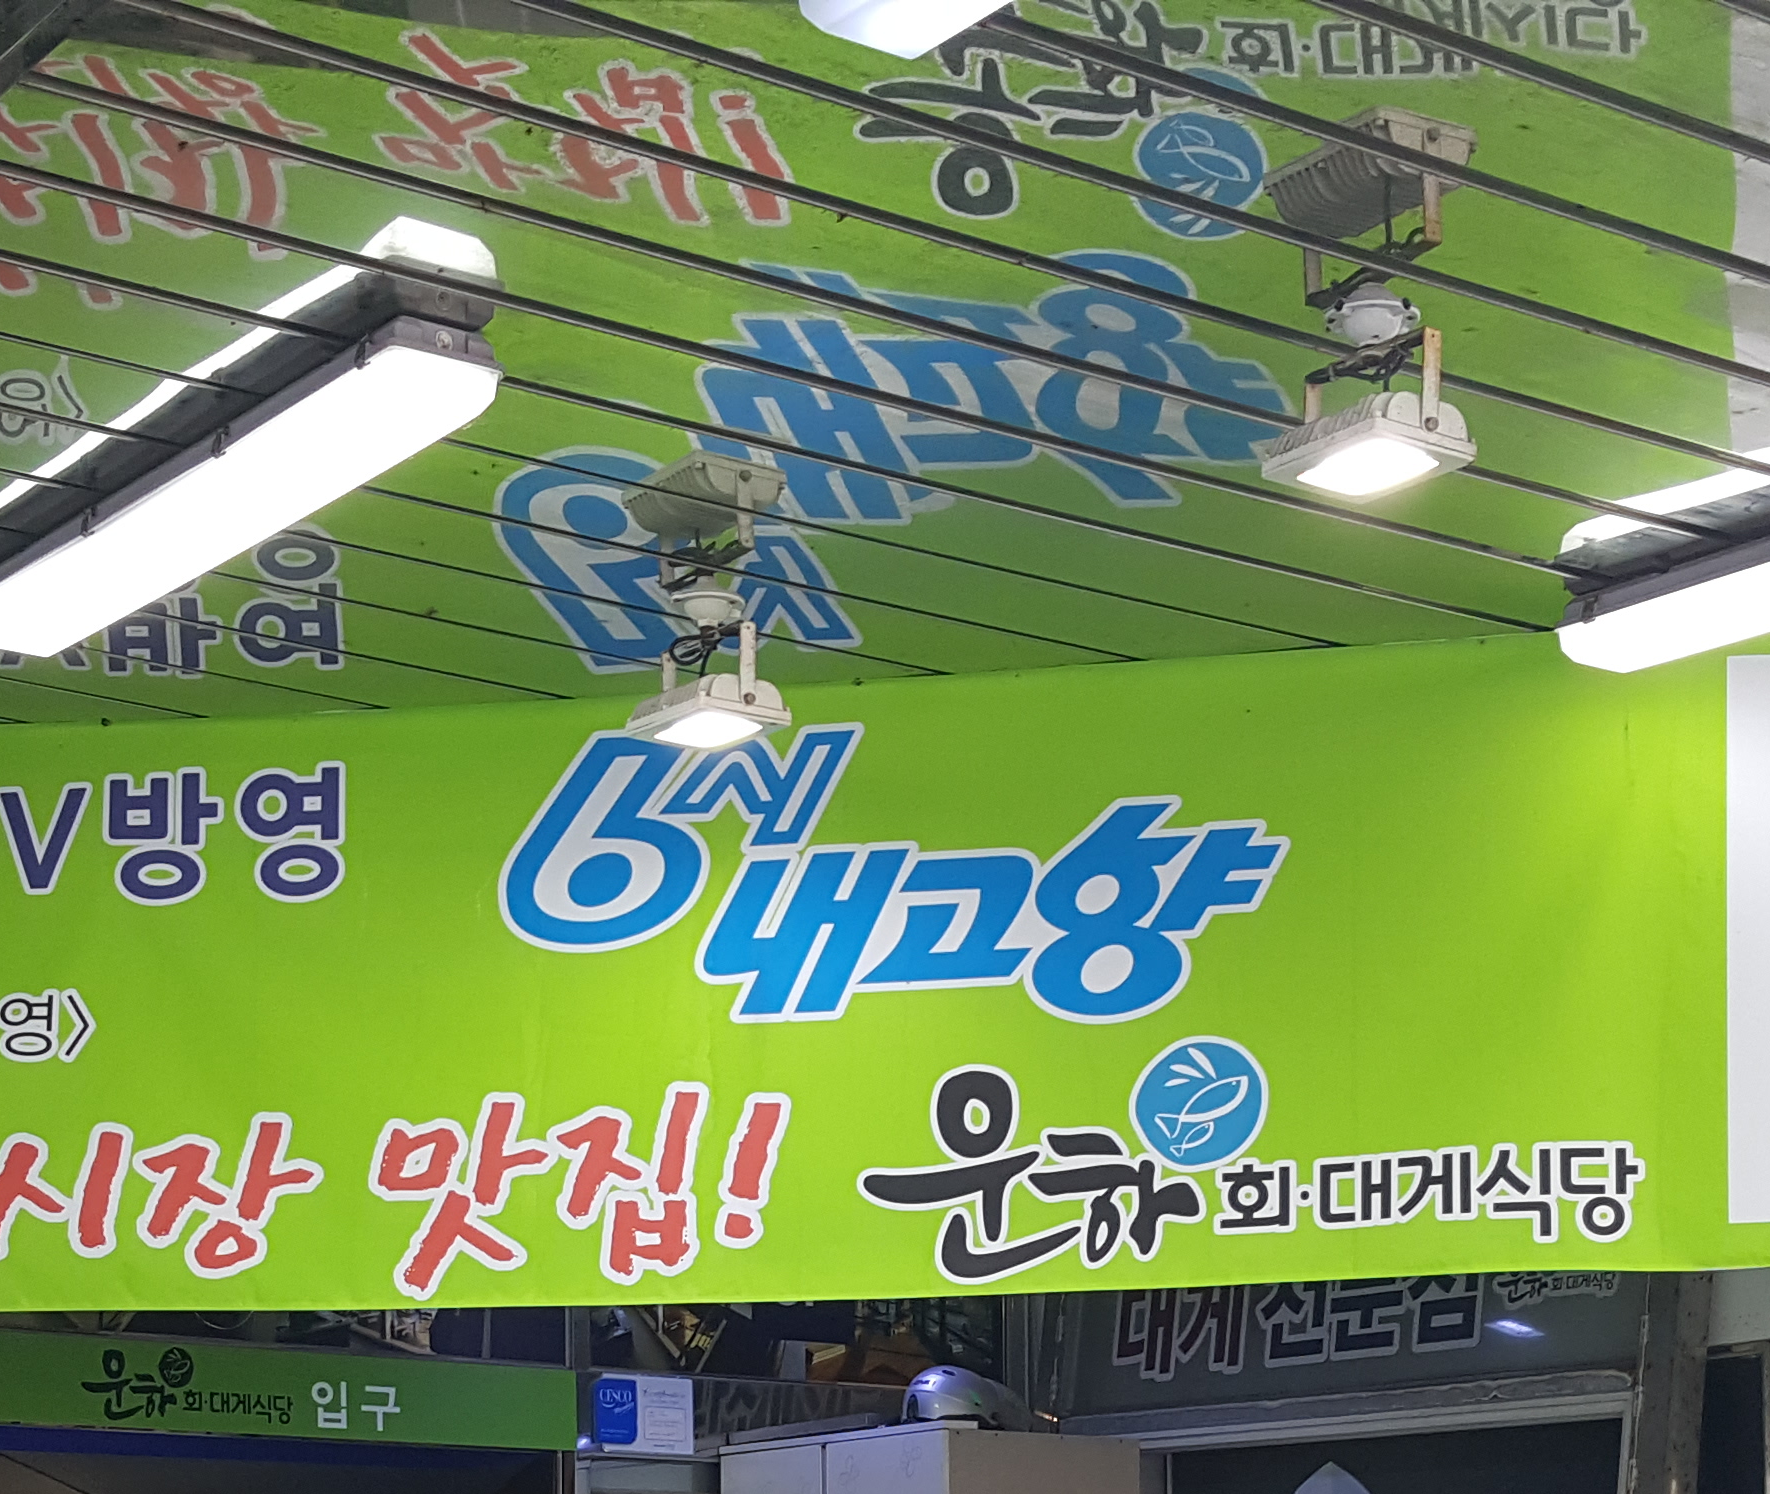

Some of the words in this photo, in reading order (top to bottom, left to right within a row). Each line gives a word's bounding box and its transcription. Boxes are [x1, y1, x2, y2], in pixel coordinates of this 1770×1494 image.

[501, 723, 863, 952] 6시
[698, 799, 1288, 1021] 내고향
[375, 1083, 788, 1297] 맛집!
[862, 1065, 1201, 1283] 운하
[81, 1349, 178, 1421] 운하
[311, 1381, 401, 1431] 입구
